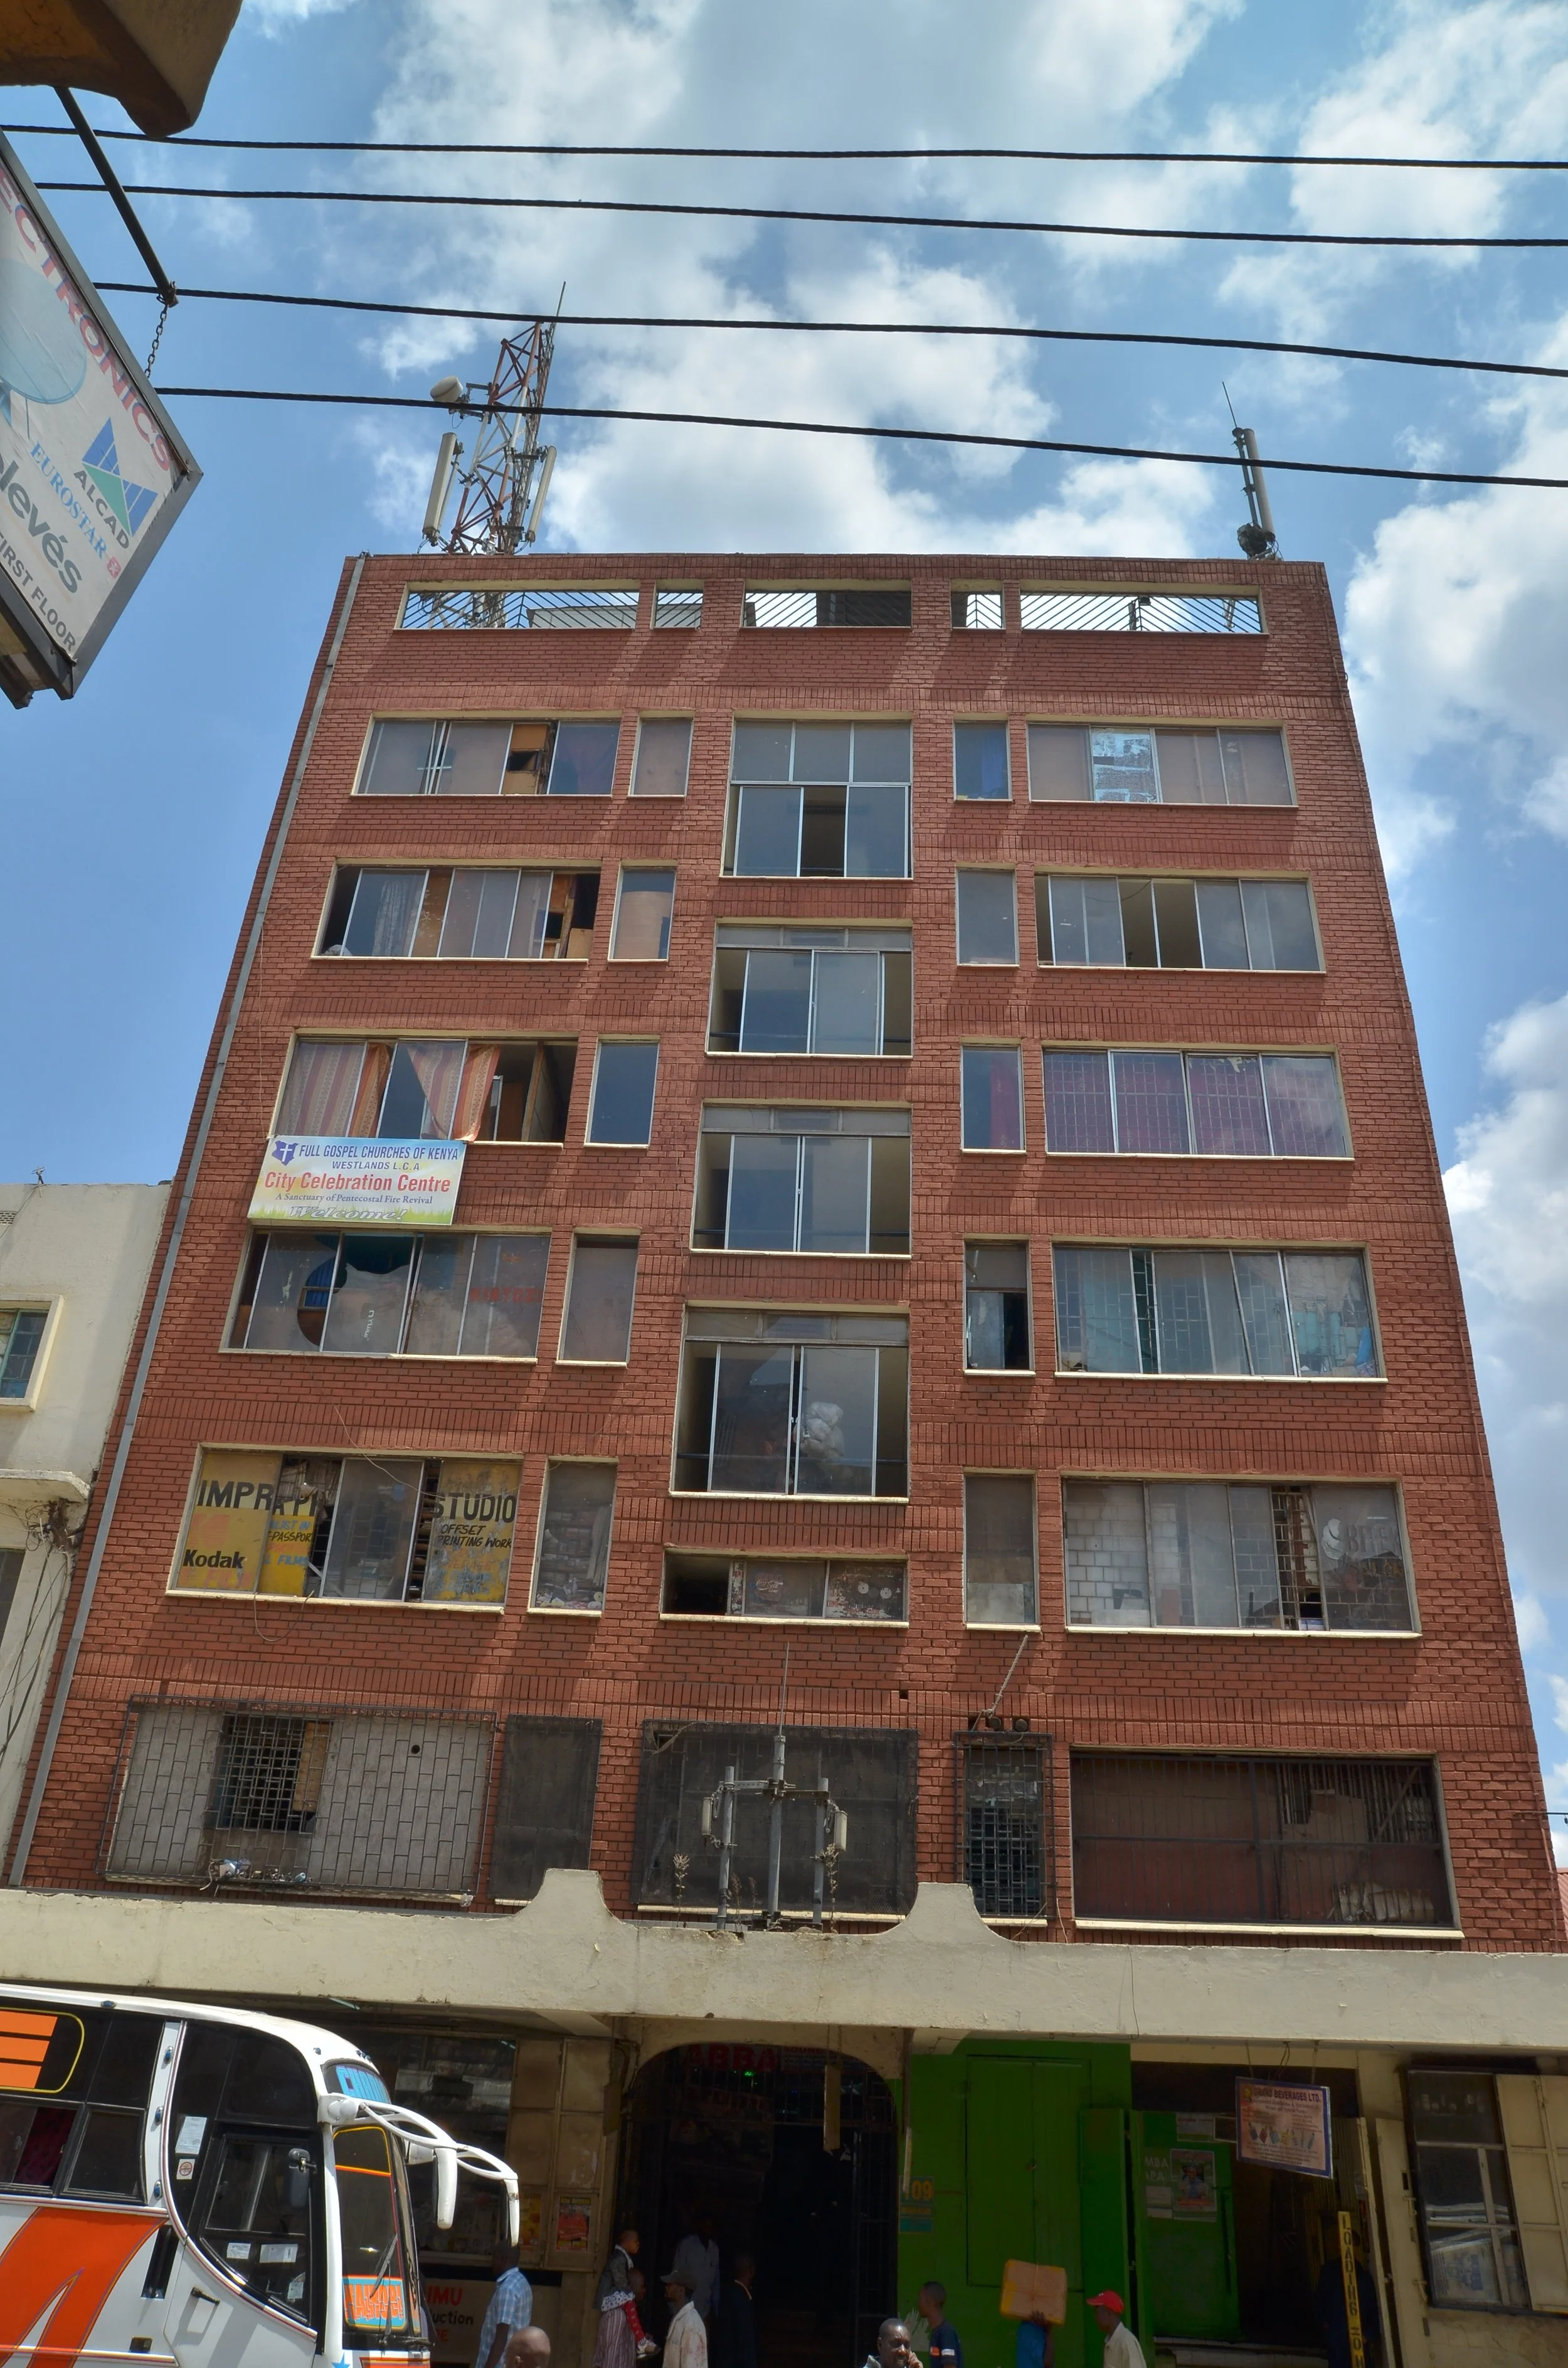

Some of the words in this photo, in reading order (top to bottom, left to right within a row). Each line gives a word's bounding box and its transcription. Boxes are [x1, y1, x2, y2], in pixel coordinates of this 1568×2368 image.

[30, 442, 109, 560] EUROSTAR
[73, 470, 130, 550] ALCAD
[0, 453, 82, 593] levés
[31, 586, 76, 652] FLOOR
[299, 1145, 320, 1157] FULL
[324, 1145, 358, 1158] GOSPEL
[362, 1146, 410, 1159] CHURCHES
[413, 1147, 425, 1159] OF
[428, 1148, 458, 1160] KENYA
[332, 1160, 390, 1170] WESTLANDS
[264, 1171, 296, 1192] City
[300, 1172, 392, 1191] Celebration
[397, 1174, 451, 1192] Centre
[284, 1194, 324, 1204] Sanctuary
[326, 1194, 336, 1202] of
[336, 1194, 383, 1203] Pentecostal
[384, 1195, 401, 1203] Fire
[403, 1196, 433, 1204] Revival
[289, 1205, 408, 1221] Welcome!
[433, 1492, 518, 1524] STUDIO
[441, 1524, 486, 1535] OFFSET
[438, 1535, 484, 1548] PRINTING
[183, 1549, 246, 1569] Kodak
[1274, 2089, 1307, 2101] BEVERAGES
[430, 2310, 474, 2326] uction
